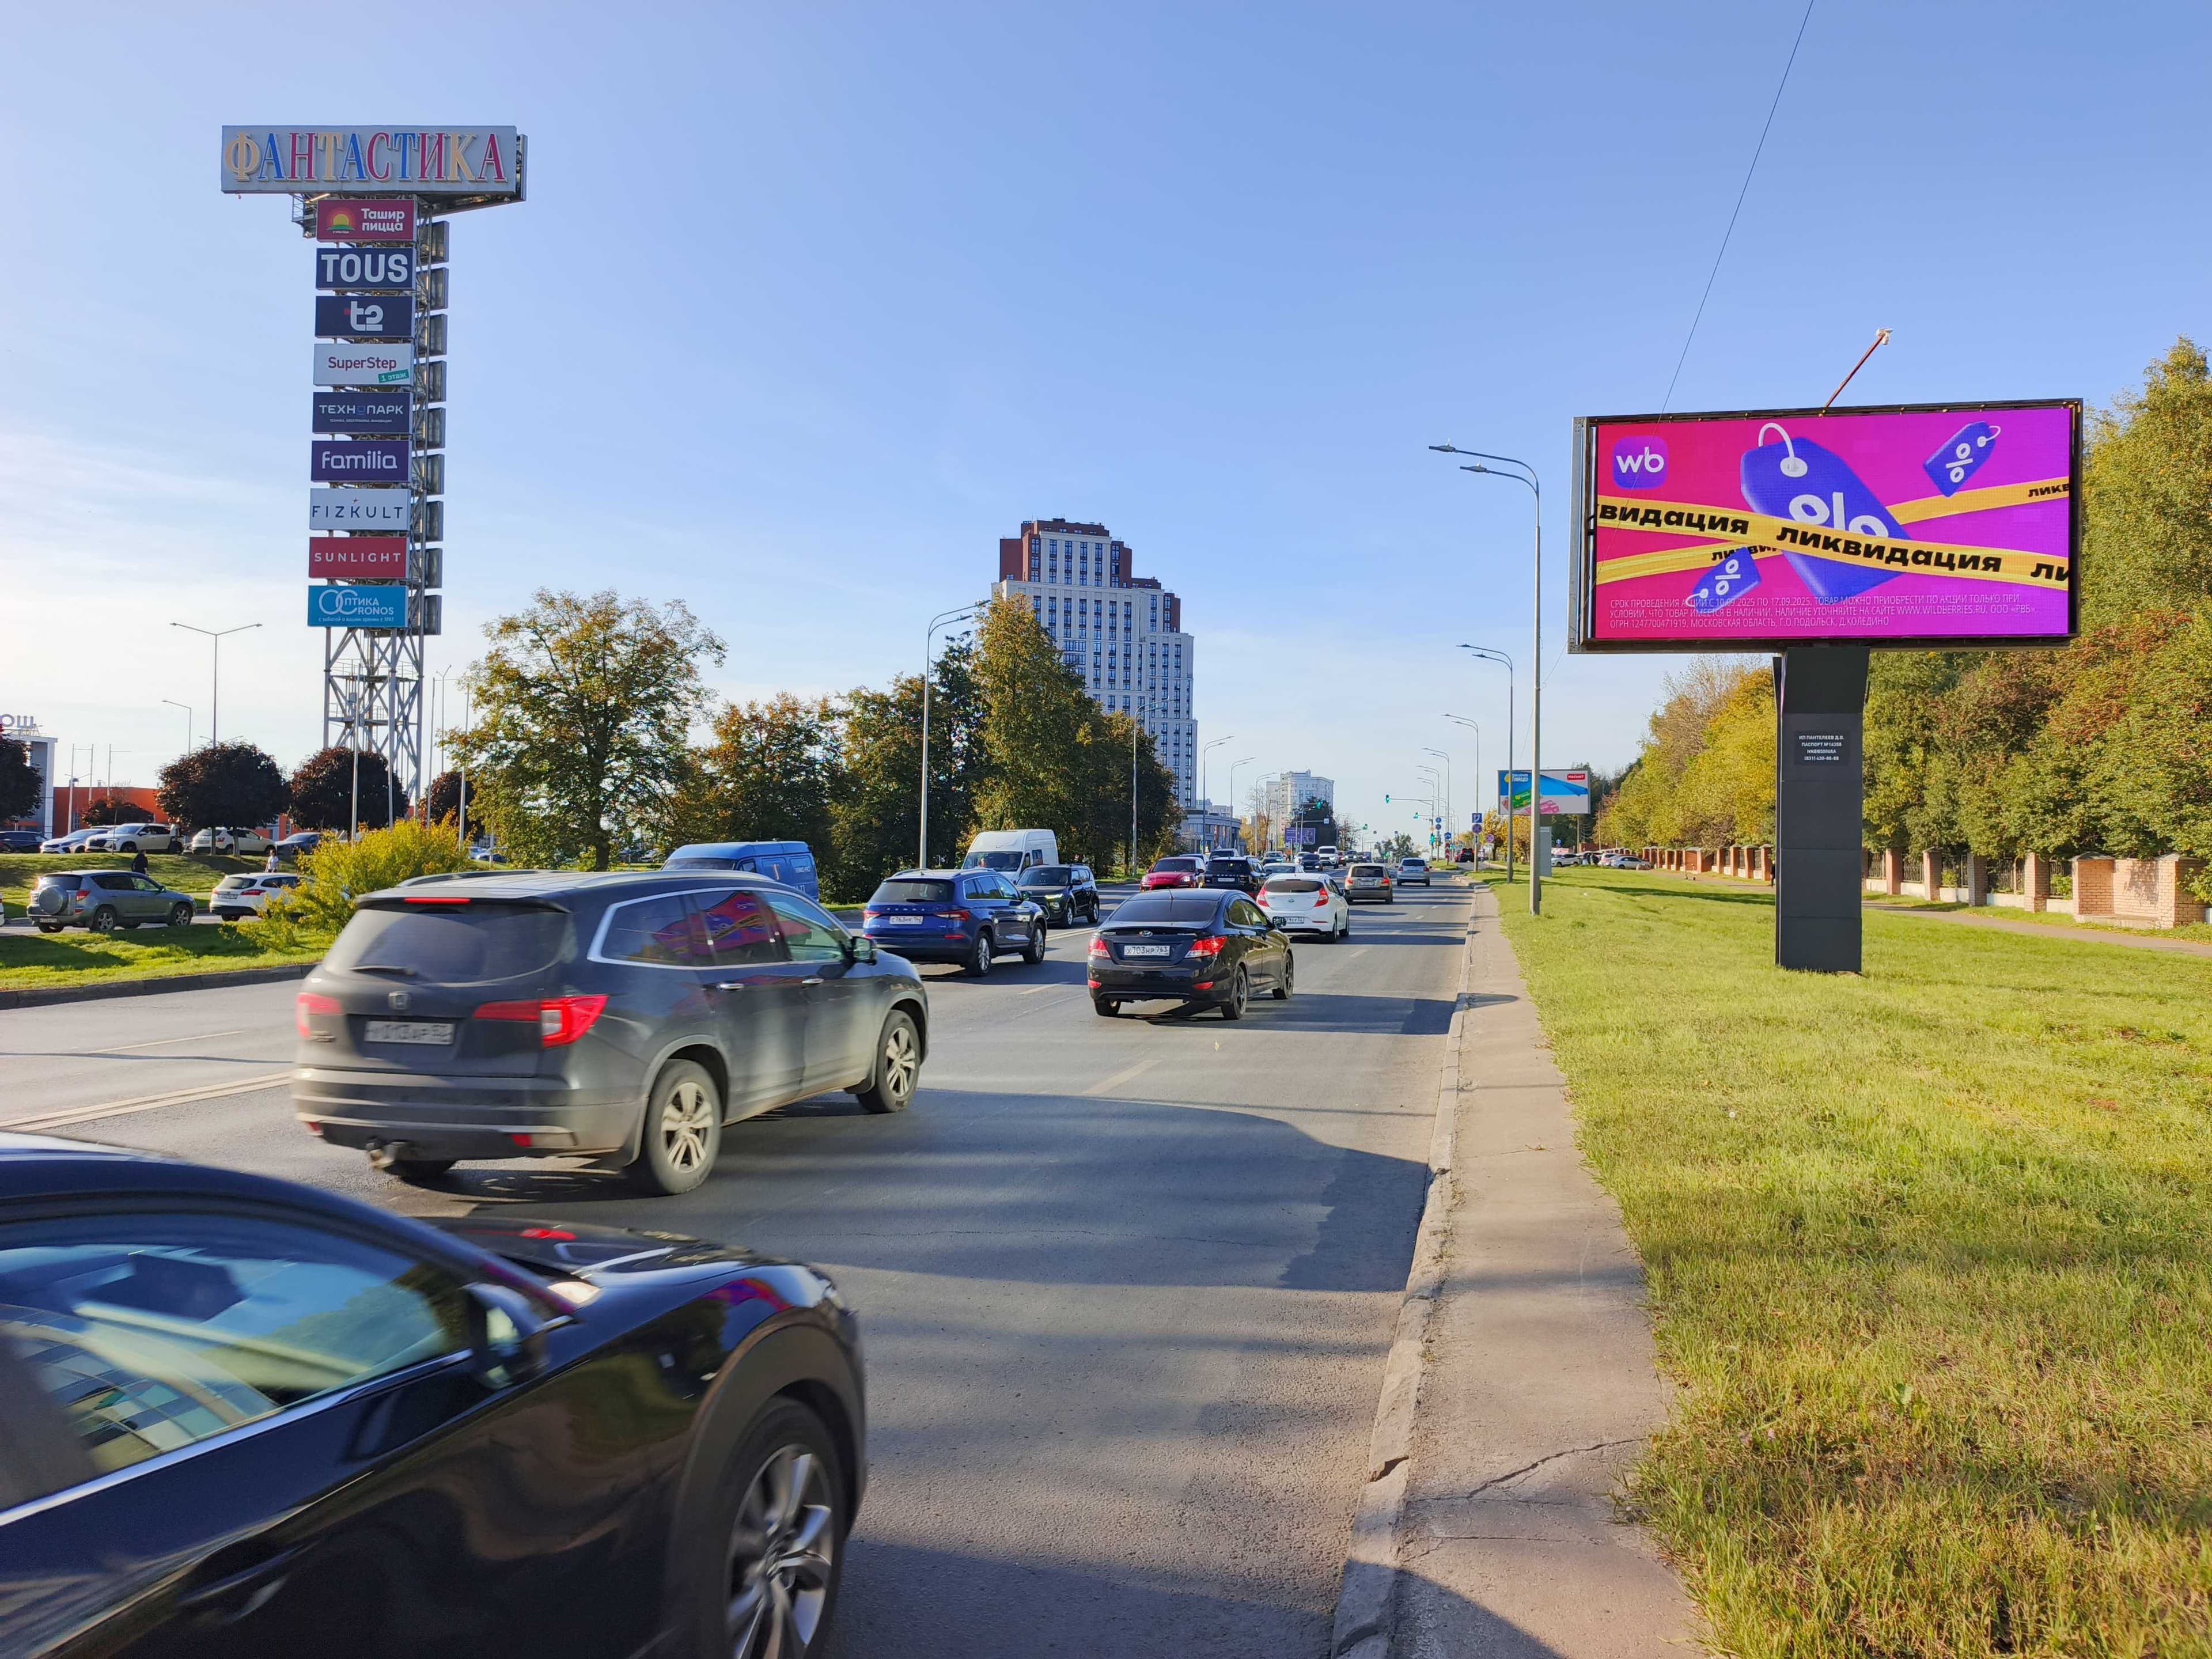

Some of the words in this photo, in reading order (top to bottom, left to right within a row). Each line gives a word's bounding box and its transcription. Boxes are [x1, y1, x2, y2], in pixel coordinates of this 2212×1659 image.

[224, 132, 507, 183] ФАНТАСТИКА
[361, 208, 405, 222] Ташир
[362, 222, 403, 232] пицца
[321, 253, 408, 283] TOUS
[350, 301, 384, 331] t2
[328, 357, 397, 372] SuperStep
[321, 450, 397, 469] familia
[1616, 446, 1665, 474] wb
[312, 506, 403, 519] FIZKULT
[1597, 504, 1749, 536] видация
[1776, 527, 2003, 572] ликвидация
[315, 552, 402, 563] SUNLIGHT
[1610, 600, 1629, 608] СРОК
[1631, 599, 1679, 608] ПРОВЕДЕНИЯ
[1758, 597, 1768, 606] ПО
[1815, 597, 1839, 605] ТОВАР
[1840, 596, 1872, 605] МОЖНО
[1874, 595, 1925, 605] ПРИОБРЕСТИ
[1926, 595, 1938, 604] ПО
[1969, 594, 2001, 604] ТОЛЬКО
[2002, 593, 2020, 603] ПРИ
[1649, 609, 1663, 618] ЧТО
[1666, 609, 1688, 618] ТОВАР
[1726, 608, 1732, 617] В
[1775, 607, 1811, 616] НАЛИЧИЕ
[1814, 606, 1857, 616] УТОЧНЯЙТЕ
[1859, 607, 1870, 615] НА
[1872, 605, 1895, 615] САЙТЕ
[1990, 605, 2009, 614] ООО
[1610, 620, 1629, 628] ОГРН
[1691, 618, 1741, 628] МОСКОВСКАЯ
